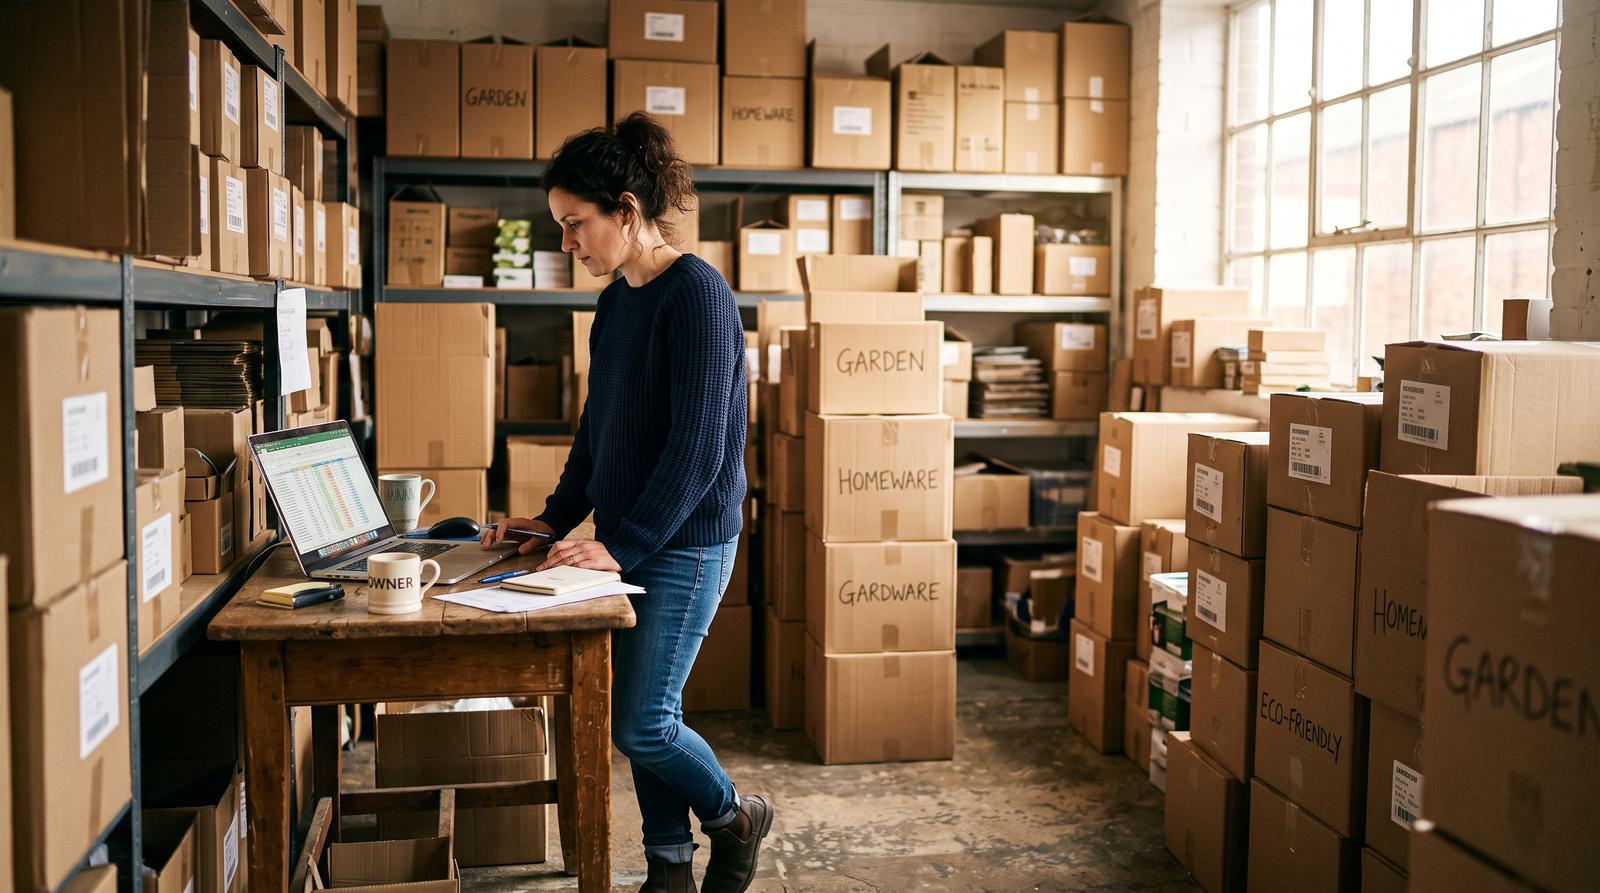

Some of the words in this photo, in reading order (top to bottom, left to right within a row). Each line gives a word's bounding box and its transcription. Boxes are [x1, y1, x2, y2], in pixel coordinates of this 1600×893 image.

[465, 86, 527, 107] GARDEN
[732, 106, 795, 122] HOMEWARE
[837, 347, 924, 377] GARDEN
[839, 467, 938, 495] HOMEWARE
[368, 576, 414, 590] OWNER
[838, 580, 940, 606] GARDWARE
[1260, 691, 1342, 765] ECO-FRIENDLY
